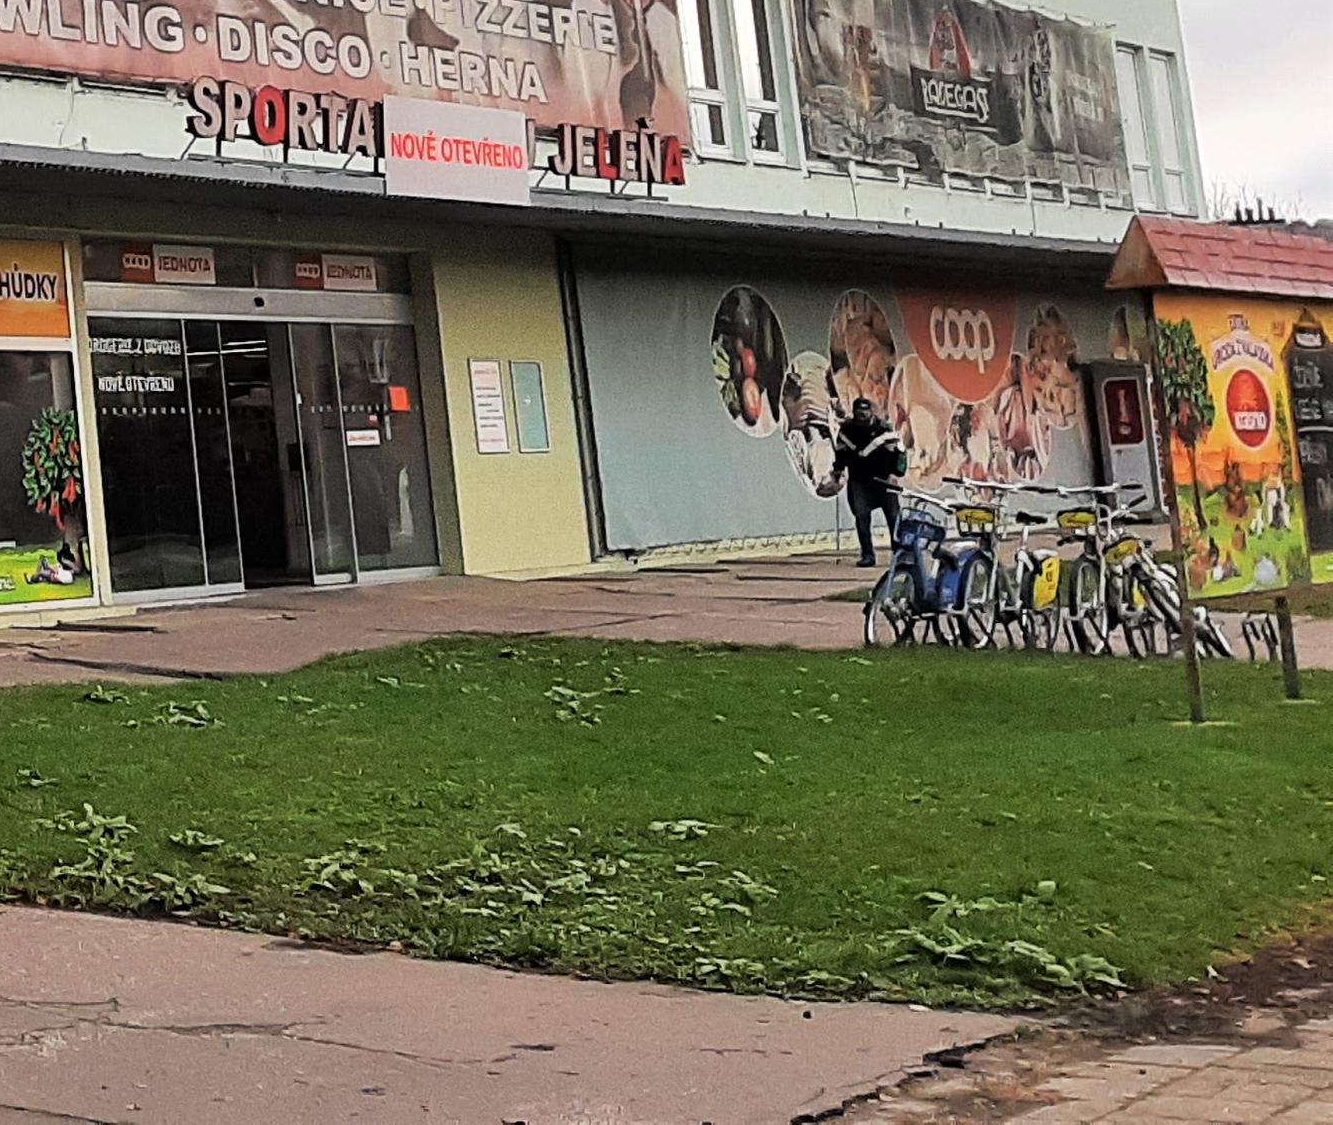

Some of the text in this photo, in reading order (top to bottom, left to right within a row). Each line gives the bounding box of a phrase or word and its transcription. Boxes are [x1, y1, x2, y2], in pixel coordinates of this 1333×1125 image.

[218, 15, 372, 79] DISCO
[398, 40, 550, 104] HERNA
[441, 135, 524, 171] OTEVŘENO
[930, 306, 995, 374] coop
